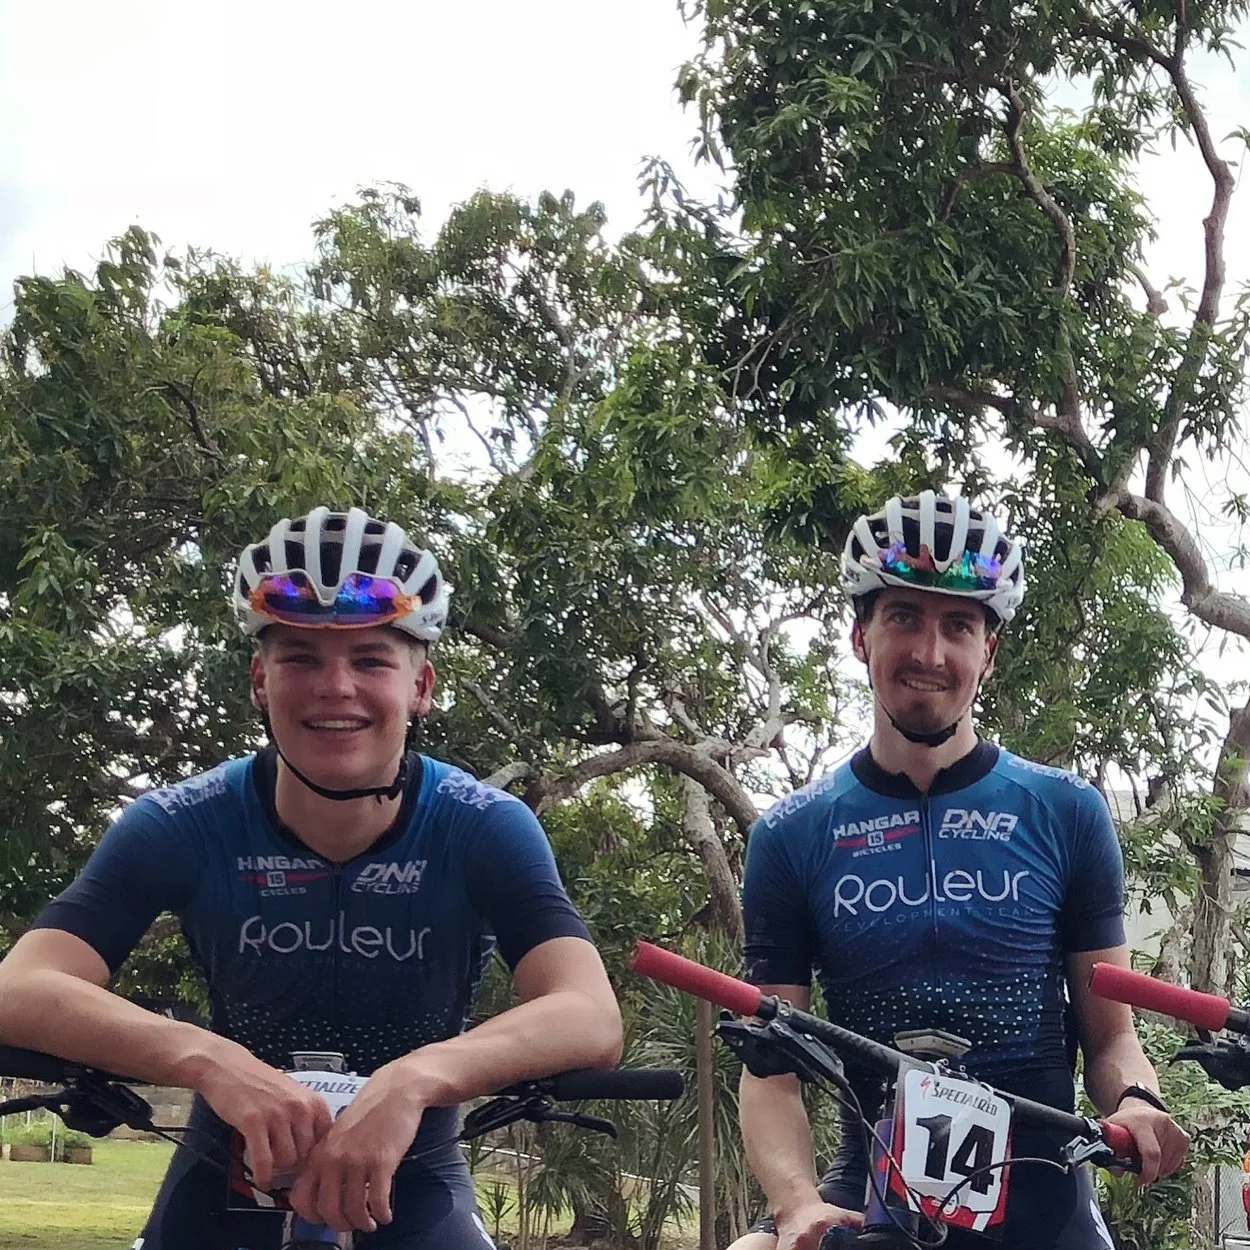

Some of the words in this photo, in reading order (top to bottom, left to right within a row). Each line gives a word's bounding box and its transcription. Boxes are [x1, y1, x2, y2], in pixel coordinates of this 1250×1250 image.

[833, 810, 920, 840] HANGAR
[941, 808, 1018, 832] DNA
[869, 832, 883, 845] 15
[938, 829, 1012, 841] CYCLING
[853, 843, 902, 857] BICYCLES
[238, 856, 325, 871] HNGAR
[356, 860, 427, 882] DNA
[268, 872, 285, 886] 15
[834, 859, 1029, 918] Rouleur
[932, 1084, 998, 1116] SPECIALIZED
[916, 1114, 995, 1195] 14
